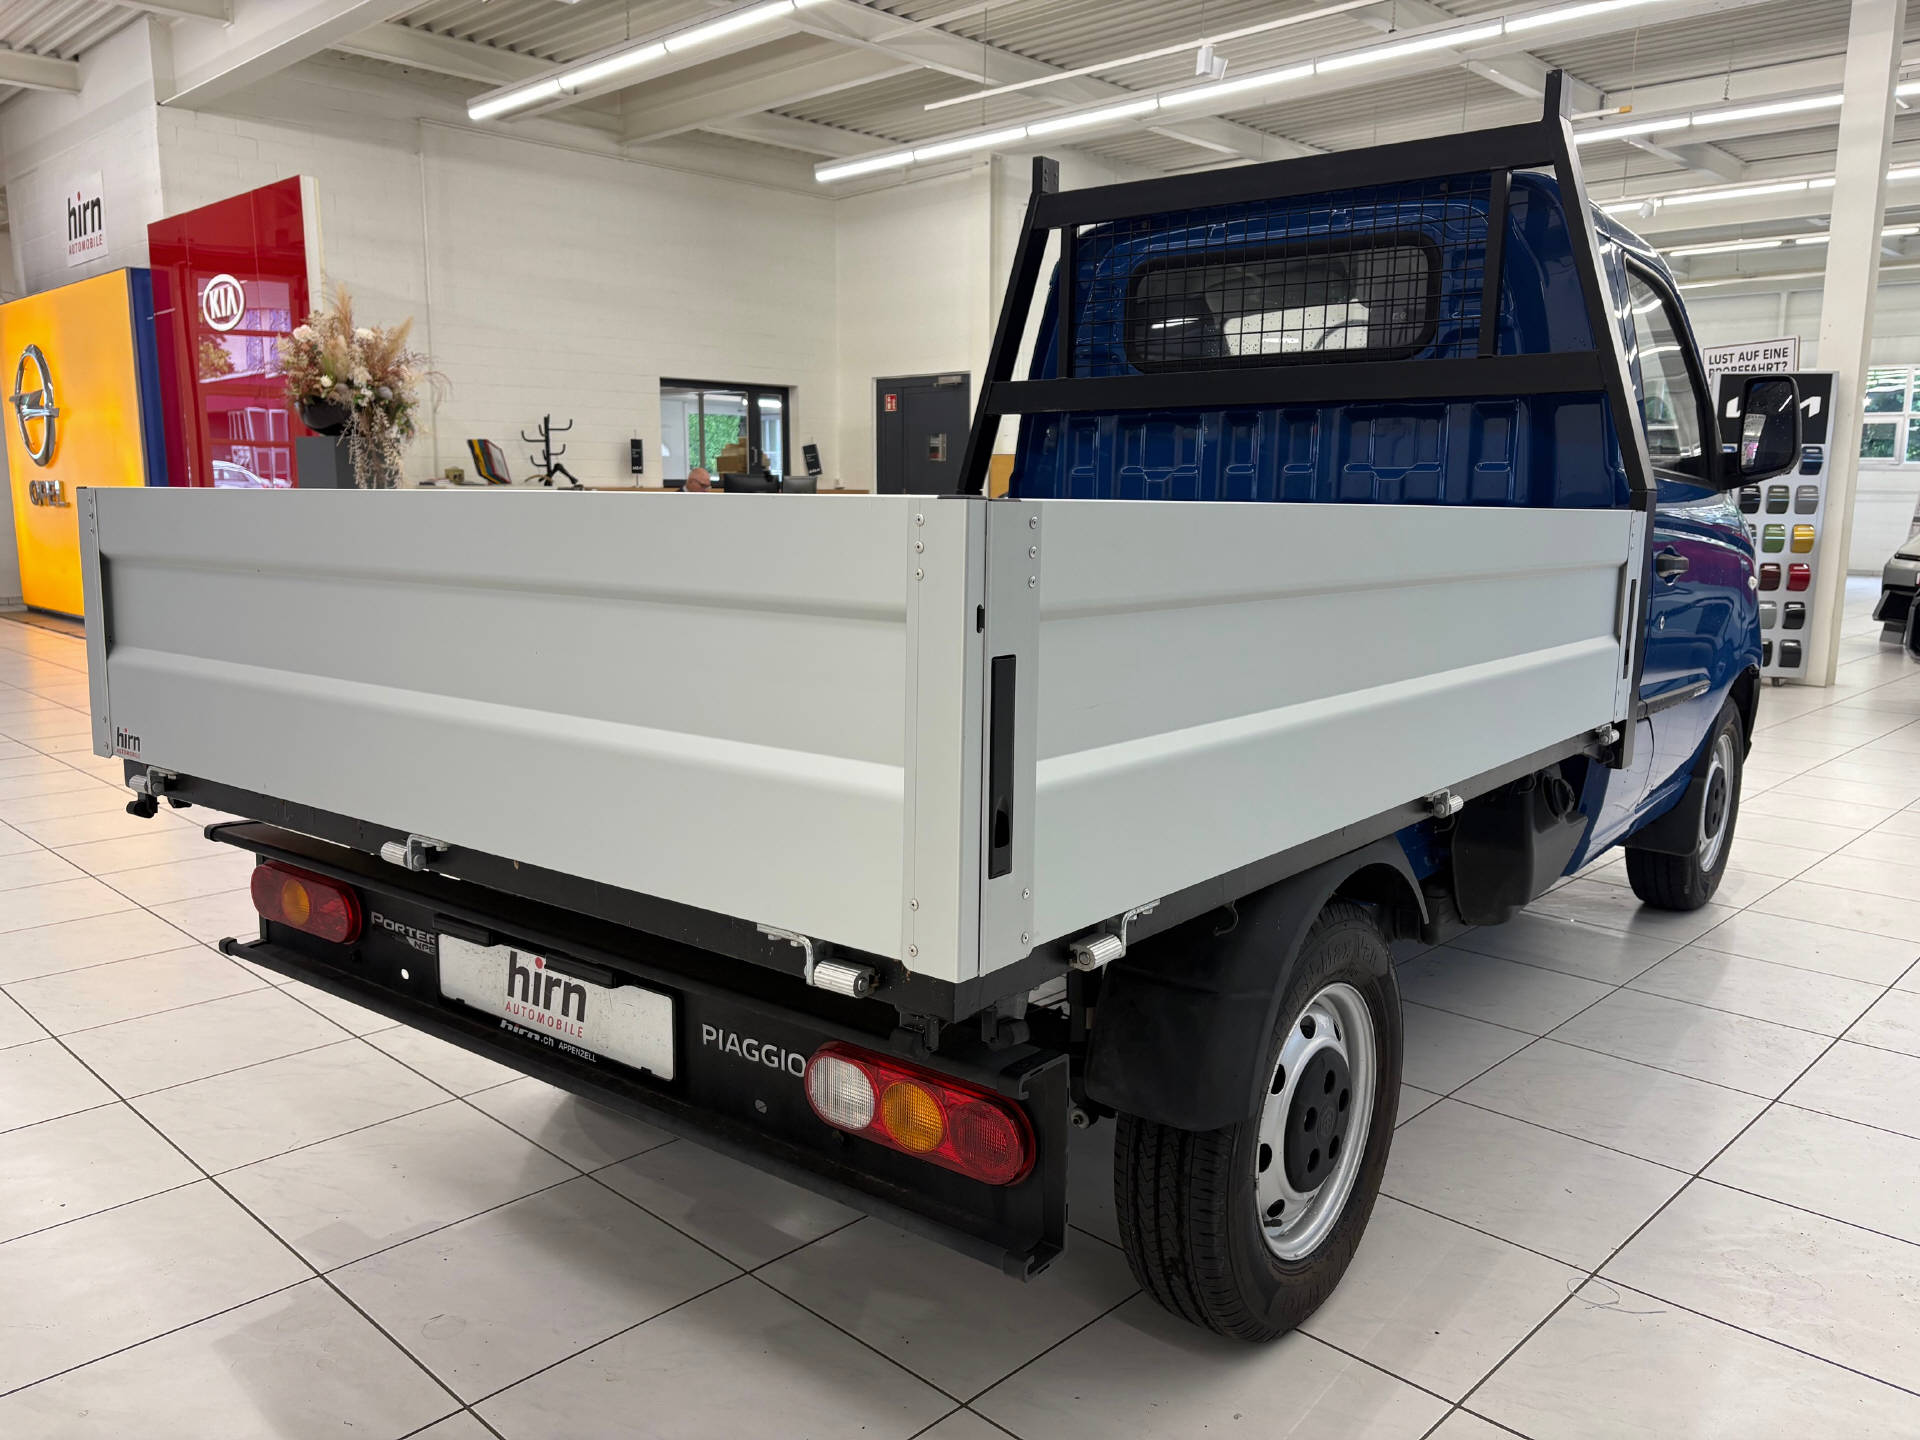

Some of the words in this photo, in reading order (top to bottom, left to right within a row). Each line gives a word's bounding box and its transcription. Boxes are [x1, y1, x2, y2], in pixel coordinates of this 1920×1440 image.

[67, 191, 102, 241] hirn
[68, 233, 103, 255] AUTOMOBILE
[209, 286, 239, 320] KIA
[1709, 353, 1735, 365] LUST
[1738, 350, 1760, 362] AUF
[1763, 347, 1789, 359] EINE
[29, 480, 70, 507] OPEL
[116, 726, 140, 752] hirn
[507, 950, 587, 1023] hirn
[505, 1001, 584, 1039] AUTOMOBILE
[558, 1041, 598, 1063] APPENZELL
[701, 1023, 807, 1078] PIAGGIO
